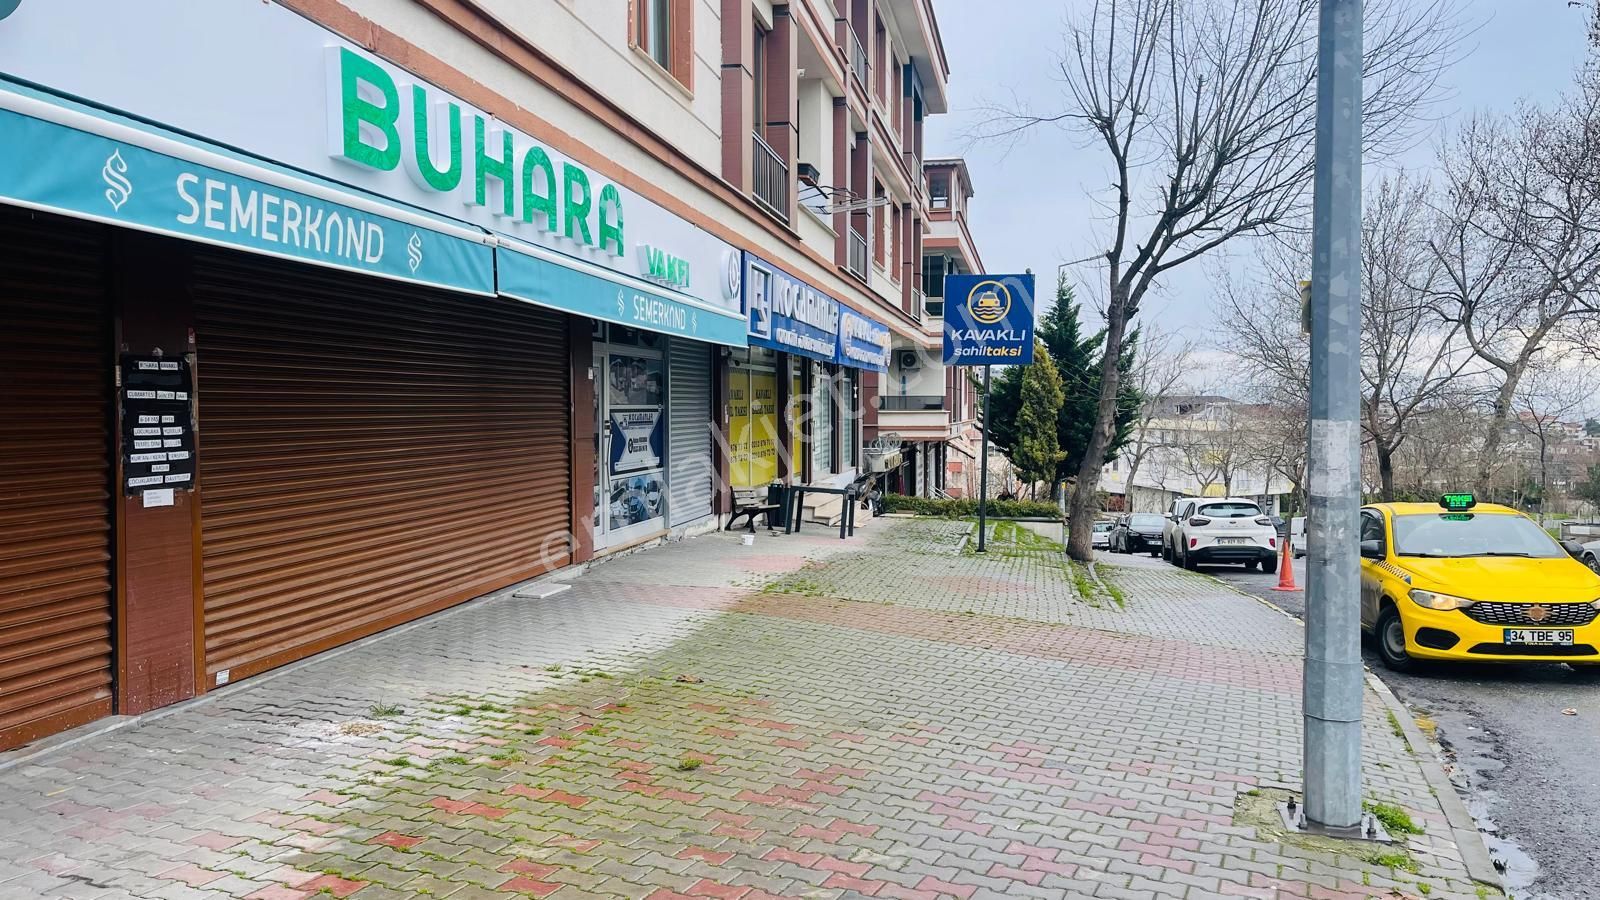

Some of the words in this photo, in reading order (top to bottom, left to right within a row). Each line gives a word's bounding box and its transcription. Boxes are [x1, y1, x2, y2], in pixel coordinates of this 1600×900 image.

[338, 47, 625, 258] BUHARA
[176, 172, 385, 264] SEMERKAND
[644, 244, 690, 289] VAKFI
[632, 294, 687, 331] SEMERKAND
[951, 329, 1027, 341] KAVAKLI
[954, 346, 1022, 357] sahiltaksi
[1511, 630, 1525, 641] 34
[1530, 630, 1553, 641] TBE
[1558, 630, 1572, 641] 95
